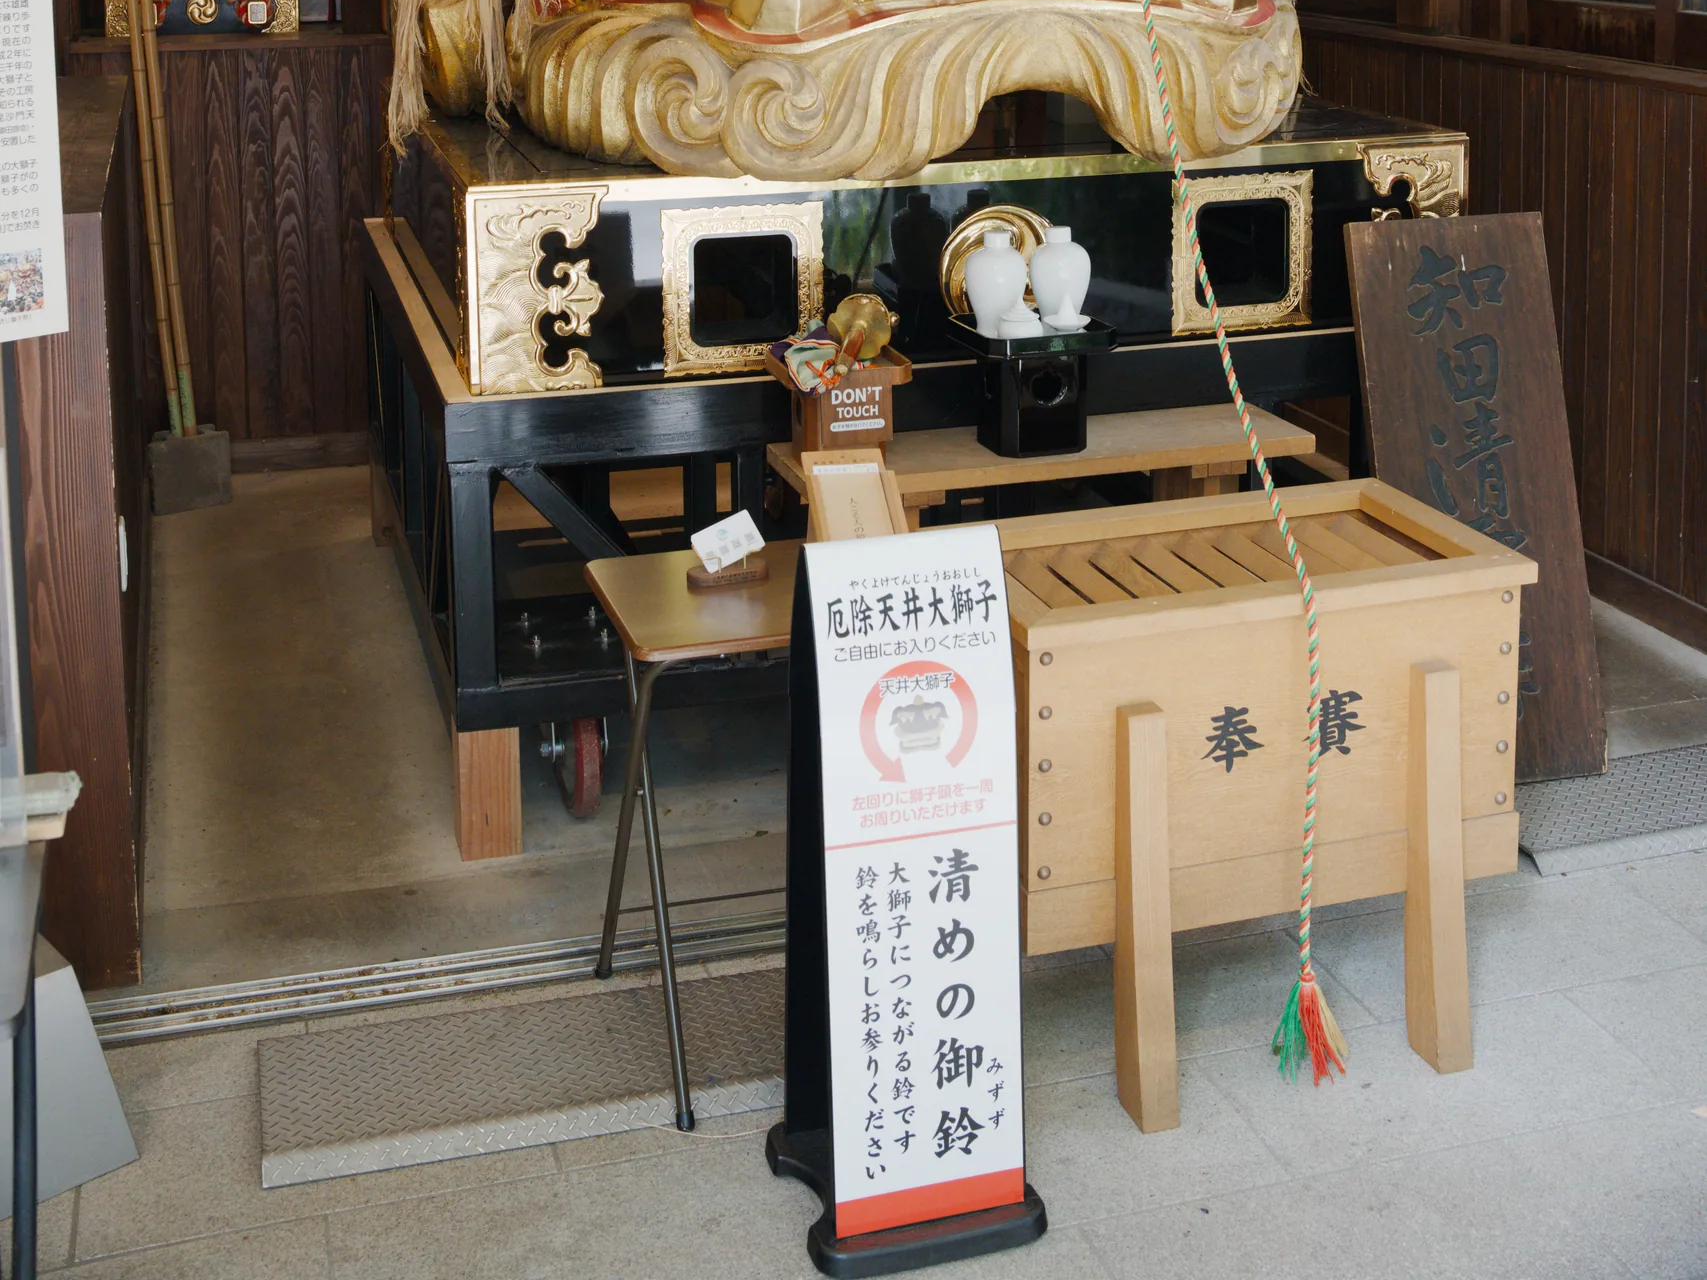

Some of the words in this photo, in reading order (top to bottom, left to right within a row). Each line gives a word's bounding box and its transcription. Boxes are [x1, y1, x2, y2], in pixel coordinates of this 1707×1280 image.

[836, 404, 879, 419] TOUCH
[849, 566, 982, 590] やくよけてんじょうおおしし
[826, 579, 998, 641] 厄除天井大獅子
[833, 630, 997, 663] ご自由にお入りください
[880, 671, 955, 696] 天井大獅子
[852, 778, 994, 811] 左回りに獅子頭を一周
[859, 798, 987, 829] お周りいただけます
[886, 861, 917, 1155] 大獅子につながる鈴です
[926, 848, 987, 1159] 清めの御鈴
[854, 865, 887, 1180] 鈴を鳴らしお参りください
[986, 1056, 1005, 1131] みずず
